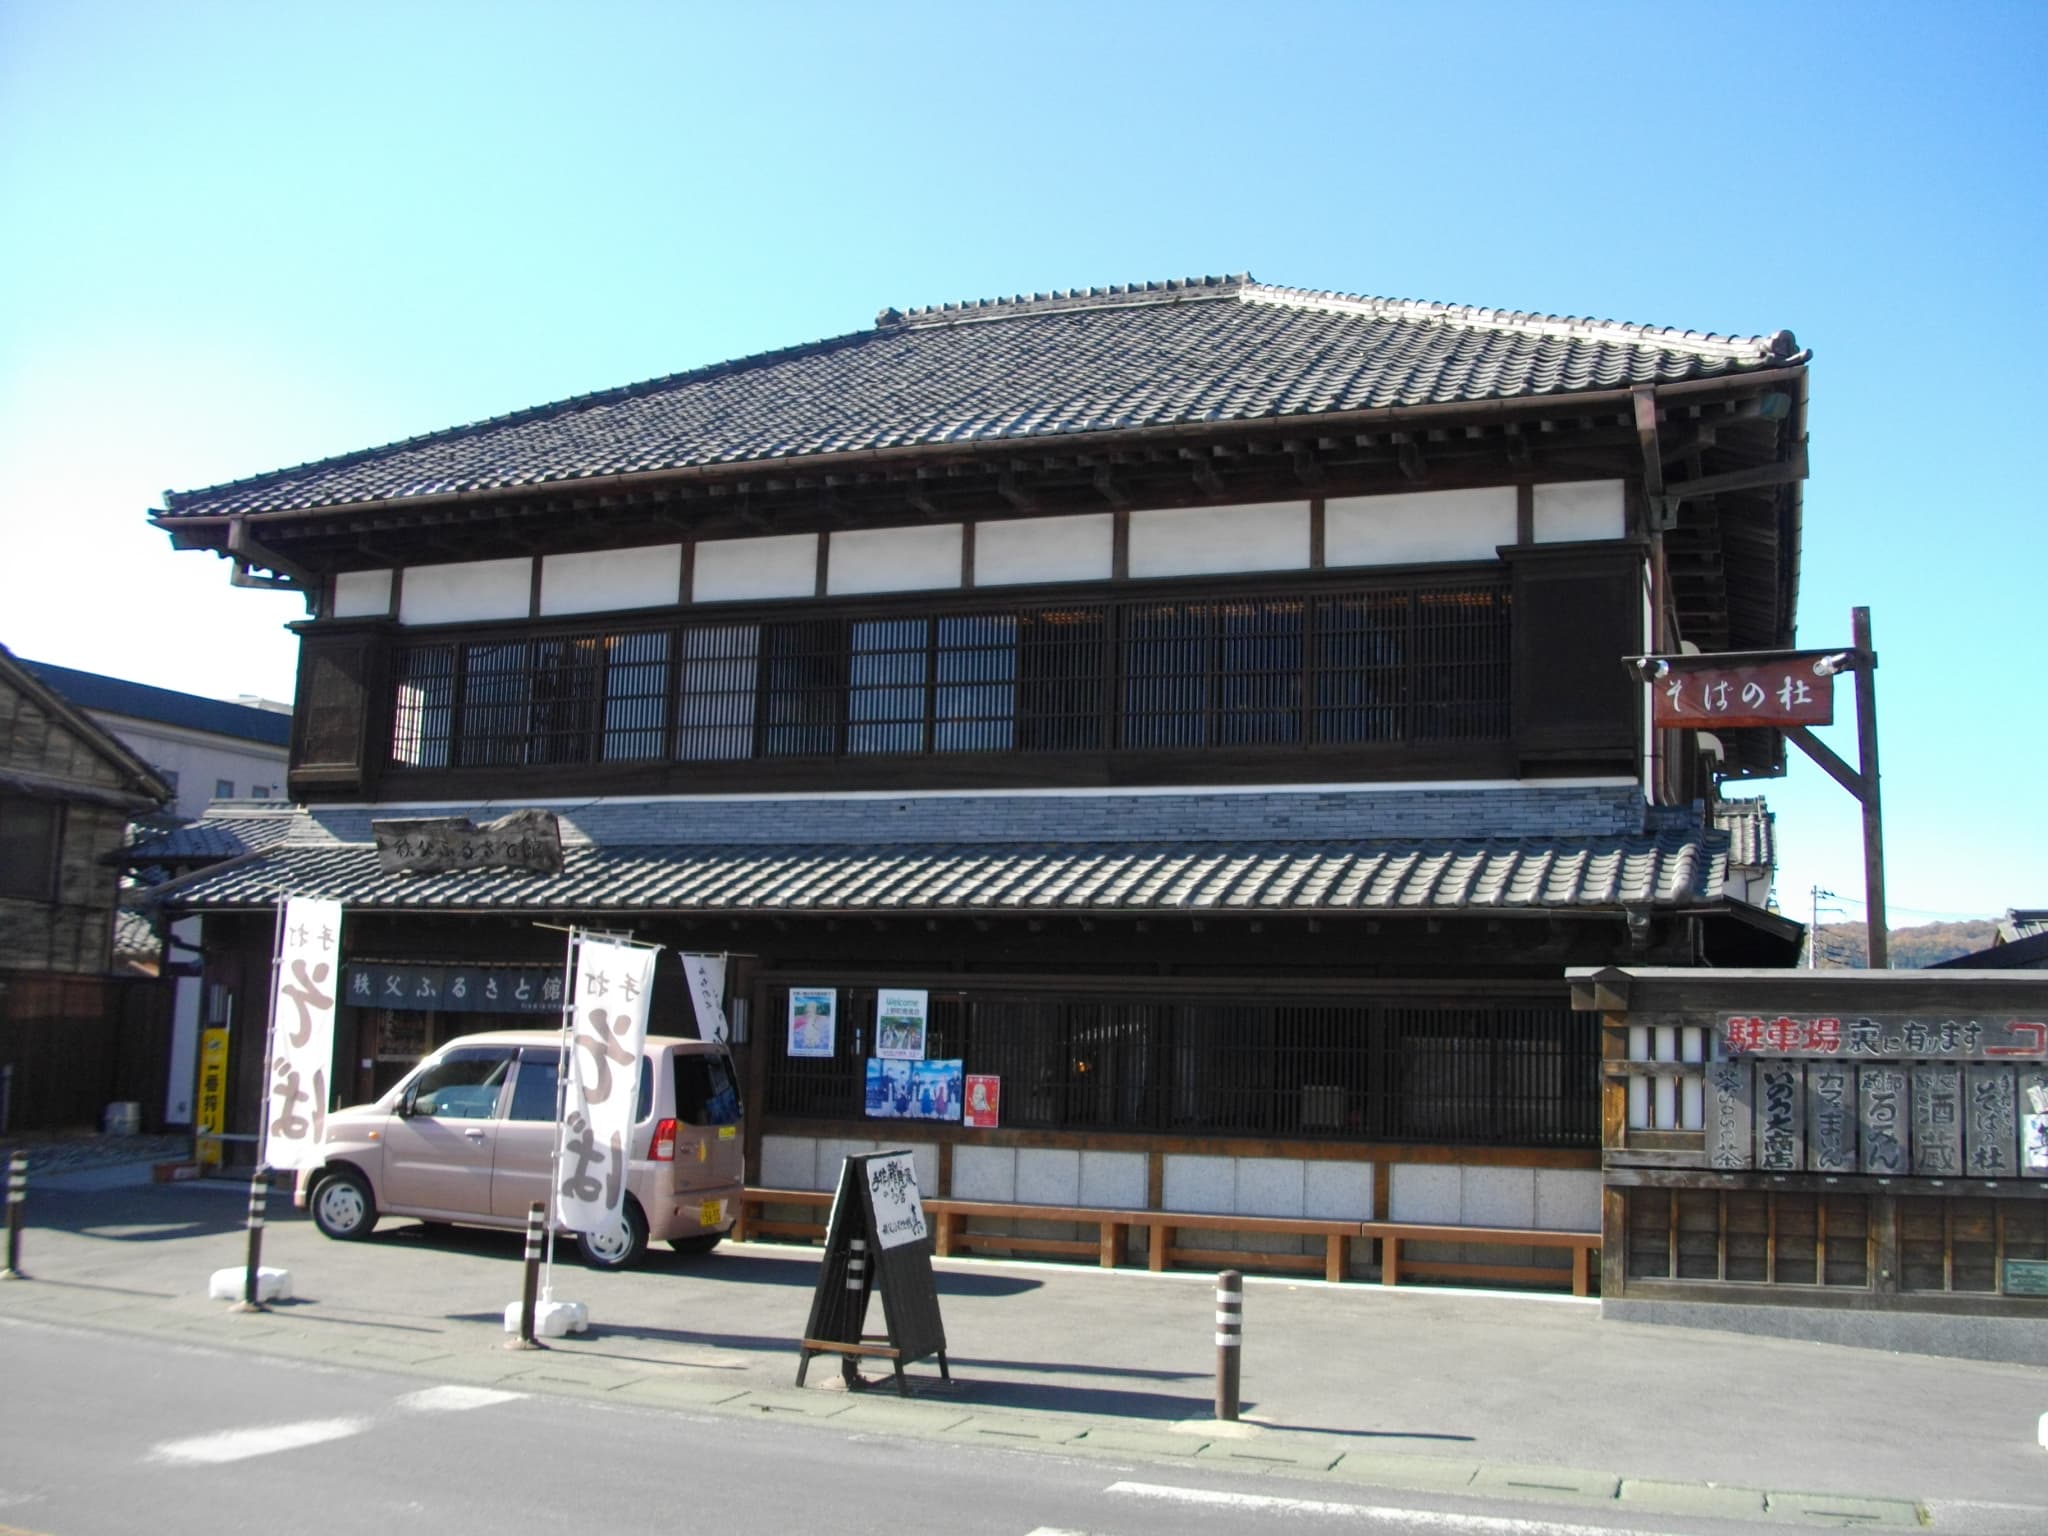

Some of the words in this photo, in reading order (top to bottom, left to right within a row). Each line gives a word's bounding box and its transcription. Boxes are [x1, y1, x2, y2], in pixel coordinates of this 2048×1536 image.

[1665, 675, 1814, 713] そばの杜
[353, 973, 563, 1001] 秩父ふるさと館
[1727, 1016, 1841, 1052] 駐車場
